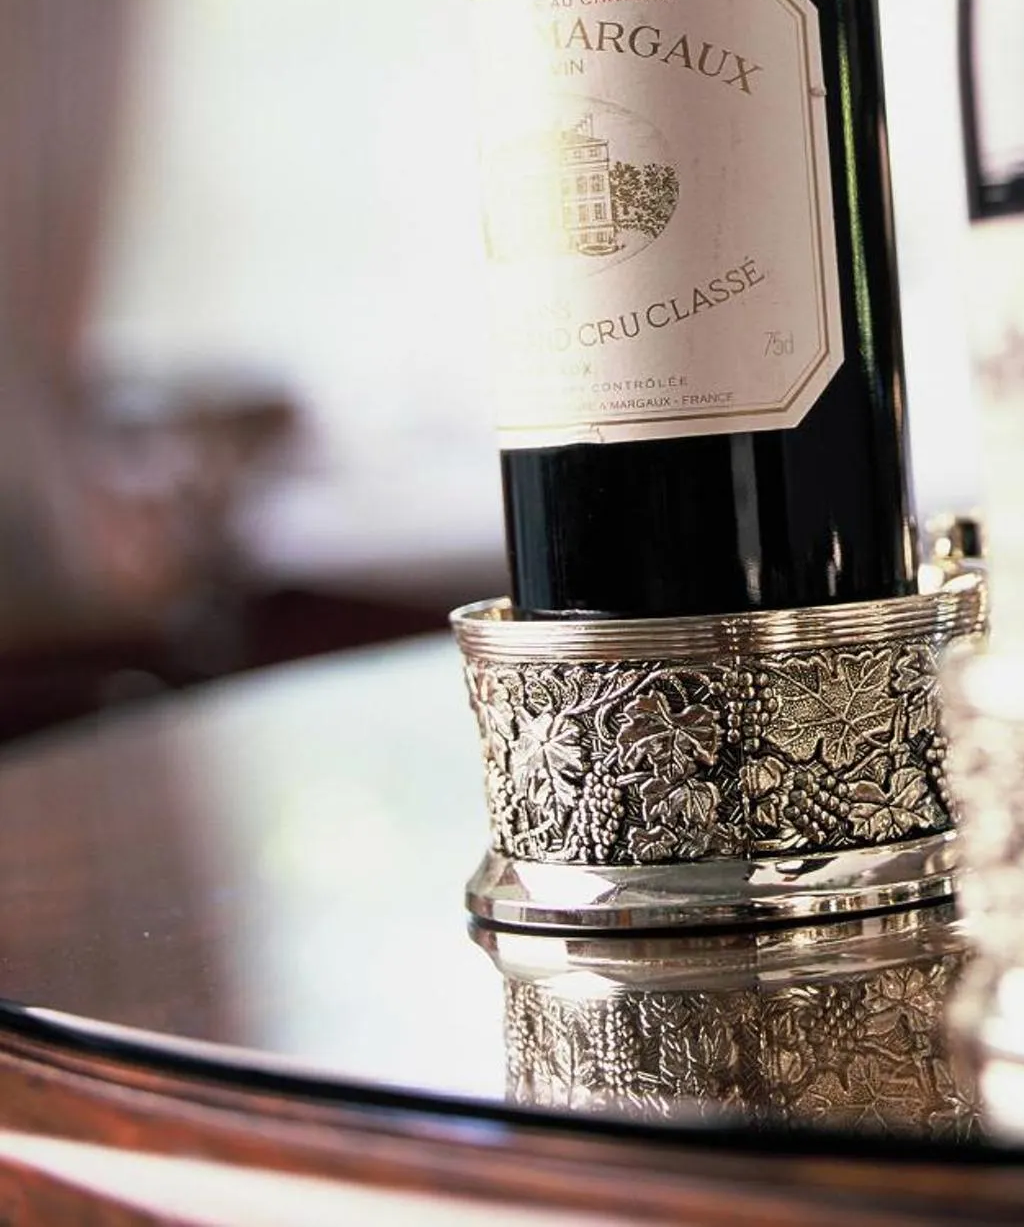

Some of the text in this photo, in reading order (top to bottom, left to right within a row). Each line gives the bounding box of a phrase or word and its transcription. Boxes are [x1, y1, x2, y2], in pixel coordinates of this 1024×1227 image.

[578, 311, 641, 348] CRU
[645, 256, 766, 329] CLASSÉ
[610, 397, 671, 411] MARGAUX
[681, 391, 735, 405] FRANCE
